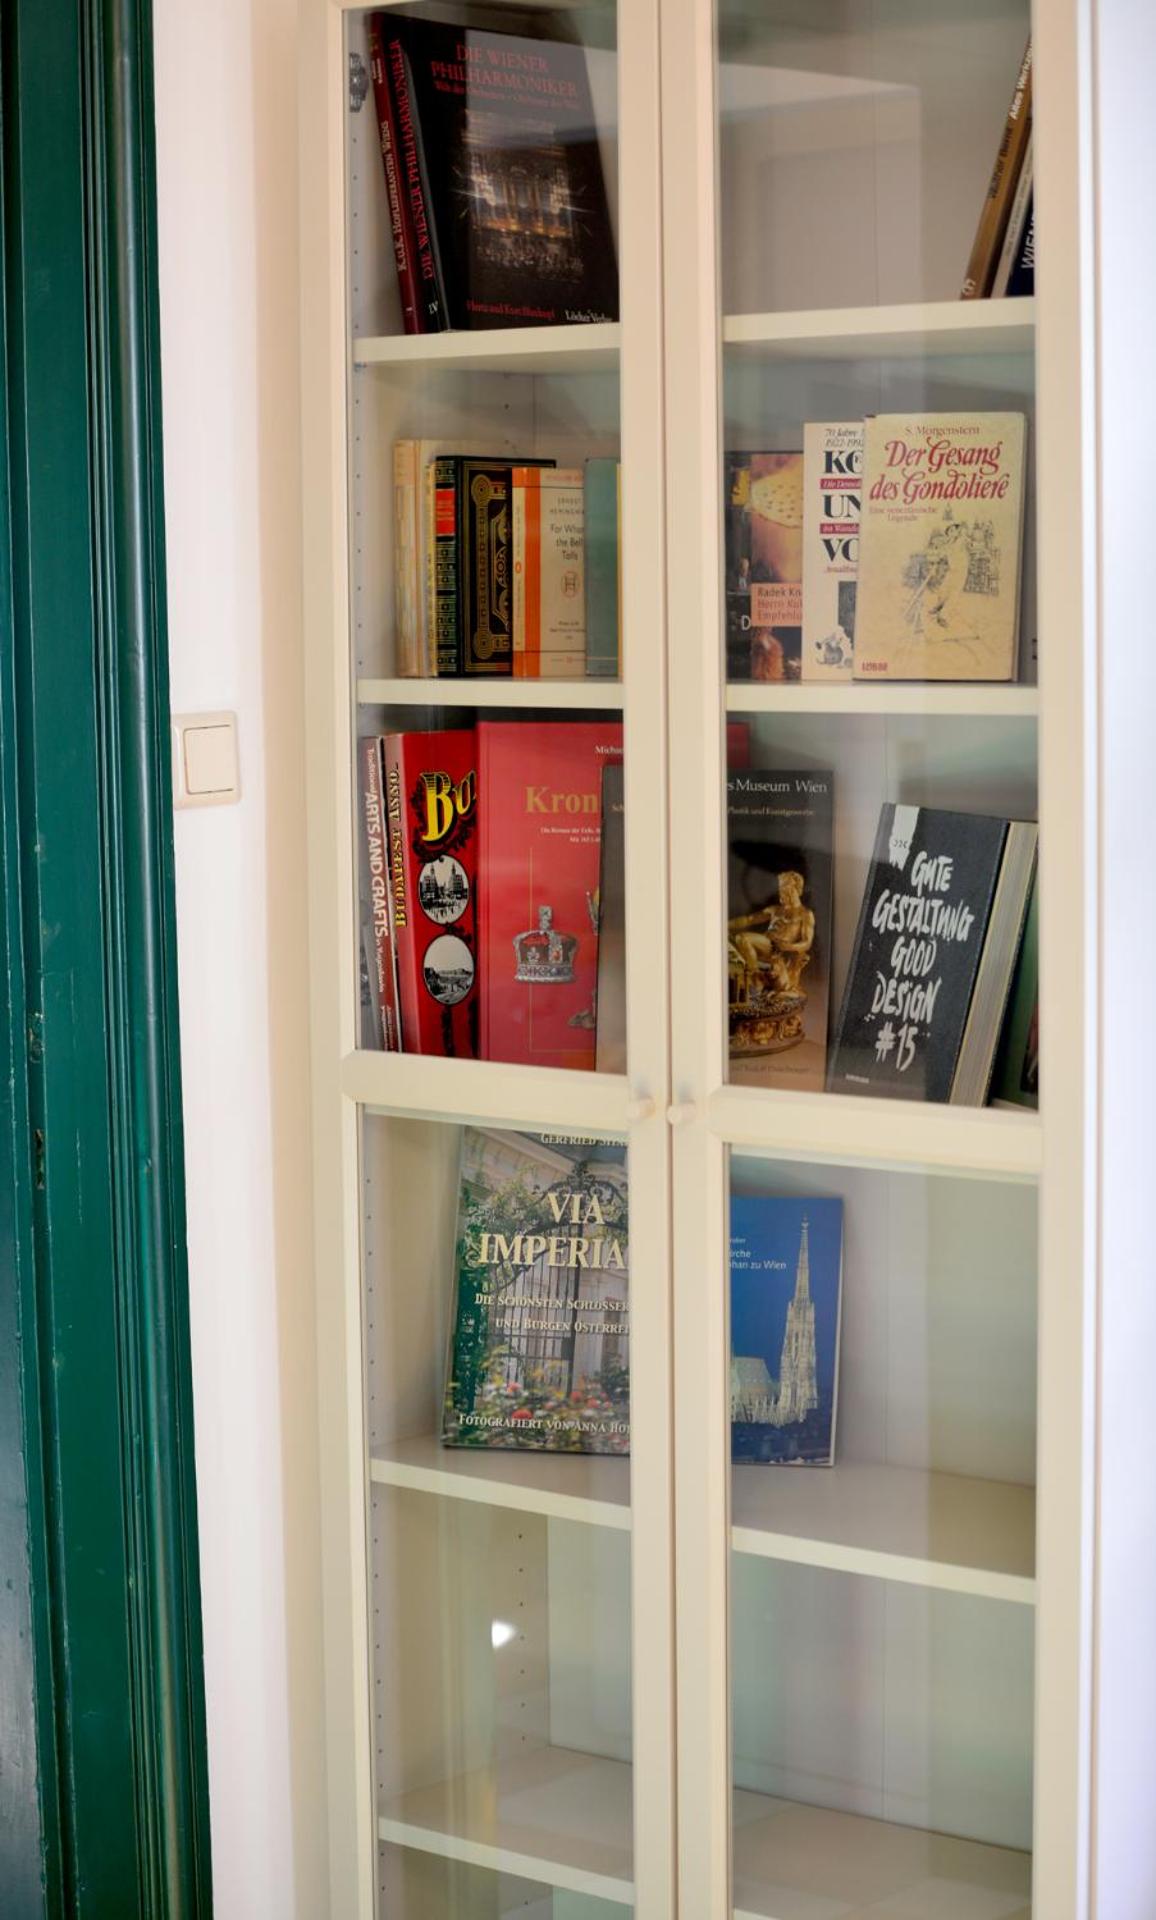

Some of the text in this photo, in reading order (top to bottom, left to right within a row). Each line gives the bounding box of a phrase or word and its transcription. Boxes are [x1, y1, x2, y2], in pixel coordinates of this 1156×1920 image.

[431, 60, 577, 96] PHILHARMONIKER
[486, 51, 549, 73] WIENER
[389, 39, 421, 185] PHILHARMONIKER
[409, 188, 431, 251] WIENER
[884, 436, 1003, 475] Der Gesang
[869, 468, 1011, 505] des Gondoliere
[525, 785, 598, 814] Kron
[736, 779, 790, 792] Museum
[795, 780, 828, 793] Wien
[364, 792, 382, 835] ARTS
[367, 836, 385, 875] AND
[911, 851, 953, 896] GUTE
[391, 828, 408, 928] BUDAPEST
[370, 874, 389, 938] CRAFTS
[872, 889, 975, 942] GESTALTUNG
[890, 936, 937, 978] GOOD
[545, 1193, 607, 1225] VIA
[477, 1232, 628, 1271] IMPERIA
[763, 1260, 787, 1270] Wien
[474, 1293, 494, 1305] DIE
[523, 1318, 572, 1332] BURGEN
[459, 1413, 543, 1429] FOTOGRAFIERT
[546, 1420, 570, 1430] VON
[573, 1420, 607, 1433] ANNA
